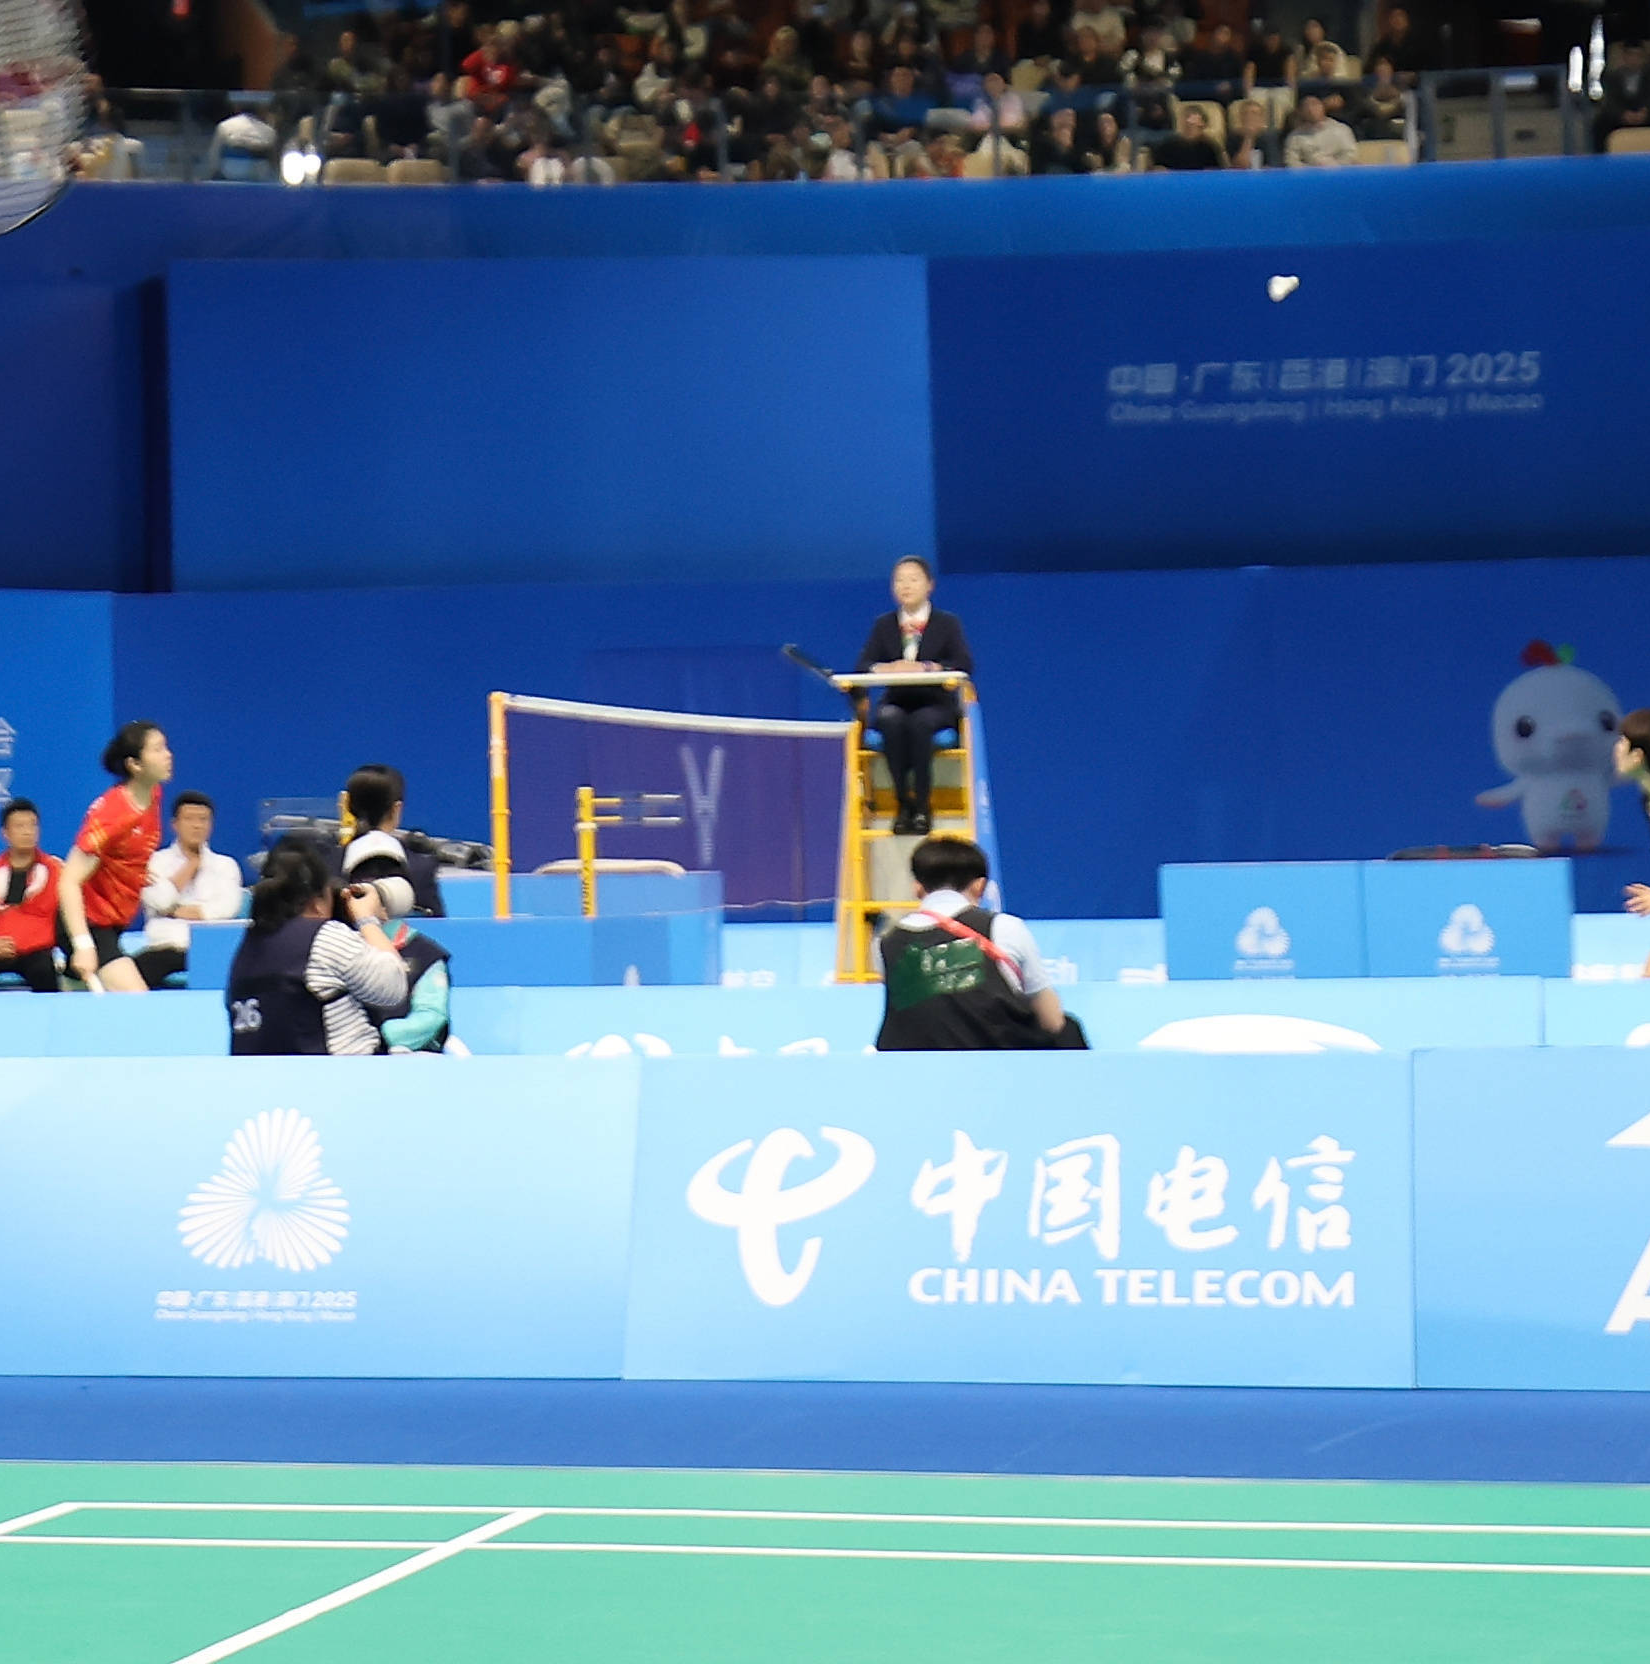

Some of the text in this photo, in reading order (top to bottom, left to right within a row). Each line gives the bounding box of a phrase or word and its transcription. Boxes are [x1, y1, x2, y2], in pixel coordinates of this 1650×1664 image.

[1446, 350, 1541, 385] 2025
[909, 1129, 1357, 1262] 中国电信
[909, 1267, 1356, 1308] CHINA TELECOM
